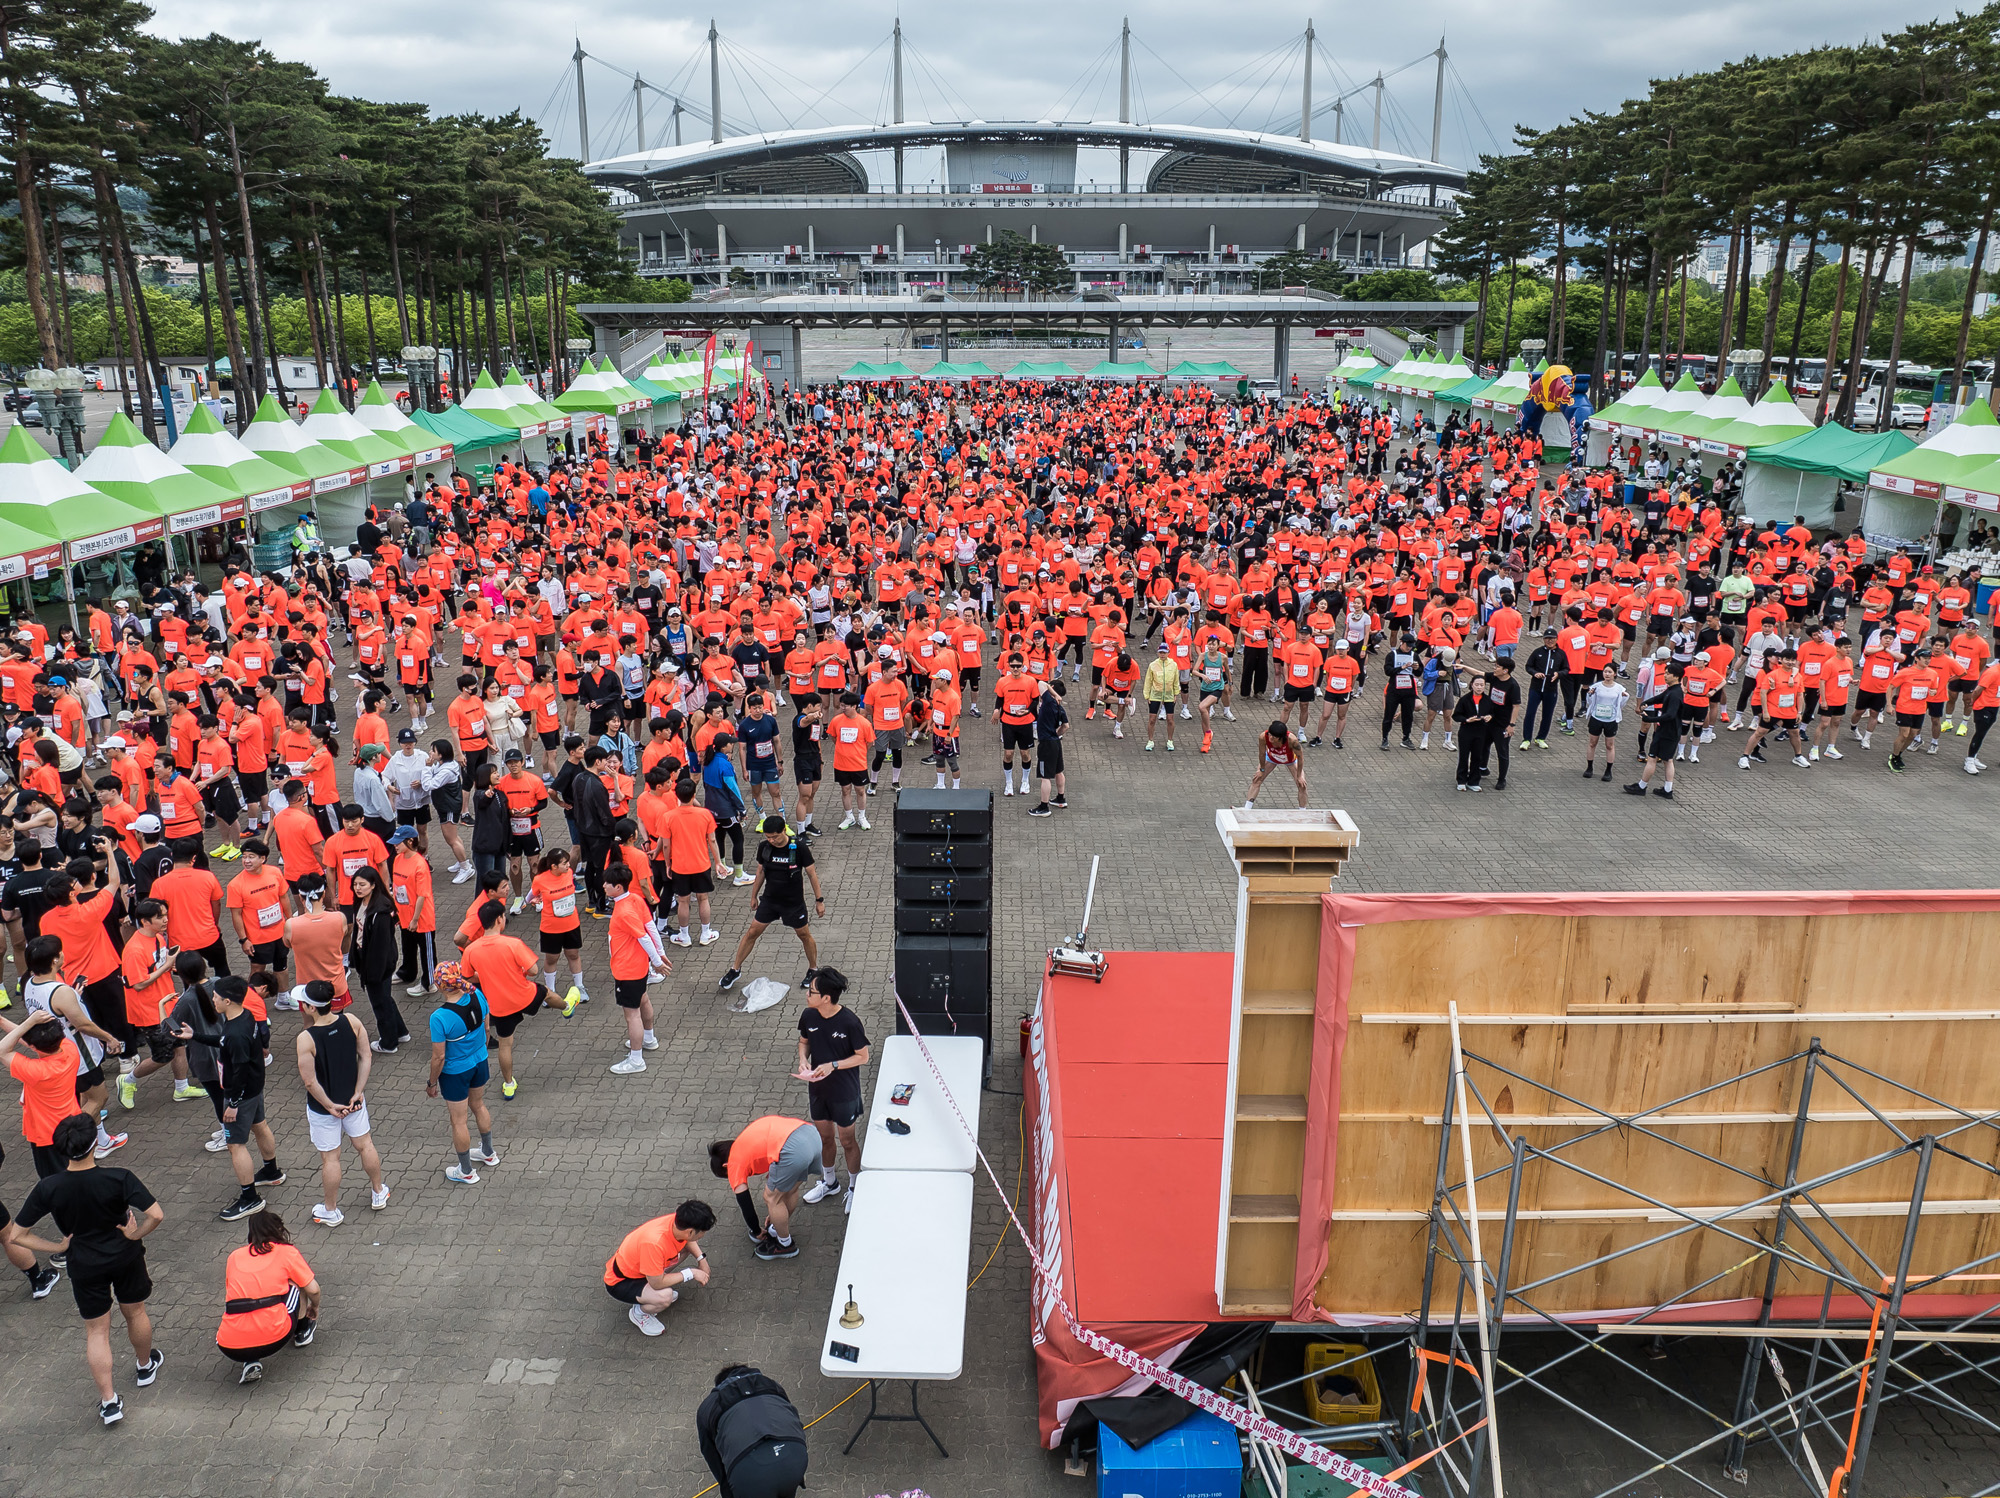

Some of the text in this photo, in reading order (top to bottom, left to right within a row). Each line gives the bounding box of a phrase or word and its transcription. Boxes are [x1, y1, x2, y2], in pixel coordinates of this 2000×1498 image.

[175, 510, 216, 527] 진행본부/도착기념품
[79, 532, 129, 554] 진행본부/도착기념품
[1114, 1348, 1146, 1372] 안전제일
[1146, 1365, 1177, 1389] DANGER!
[1178, 1381, 1195, 1398] 위험
[1217, 1401, 1253, 1427] 안전제일
[1252, 1420, 1287, 1444] DANGER!
[1288, 1437, 1307, 1456] 위험
[1310, 1450, 1329, 1465] 危險
[1331, 1459, 1371, 1486] 안전제일
